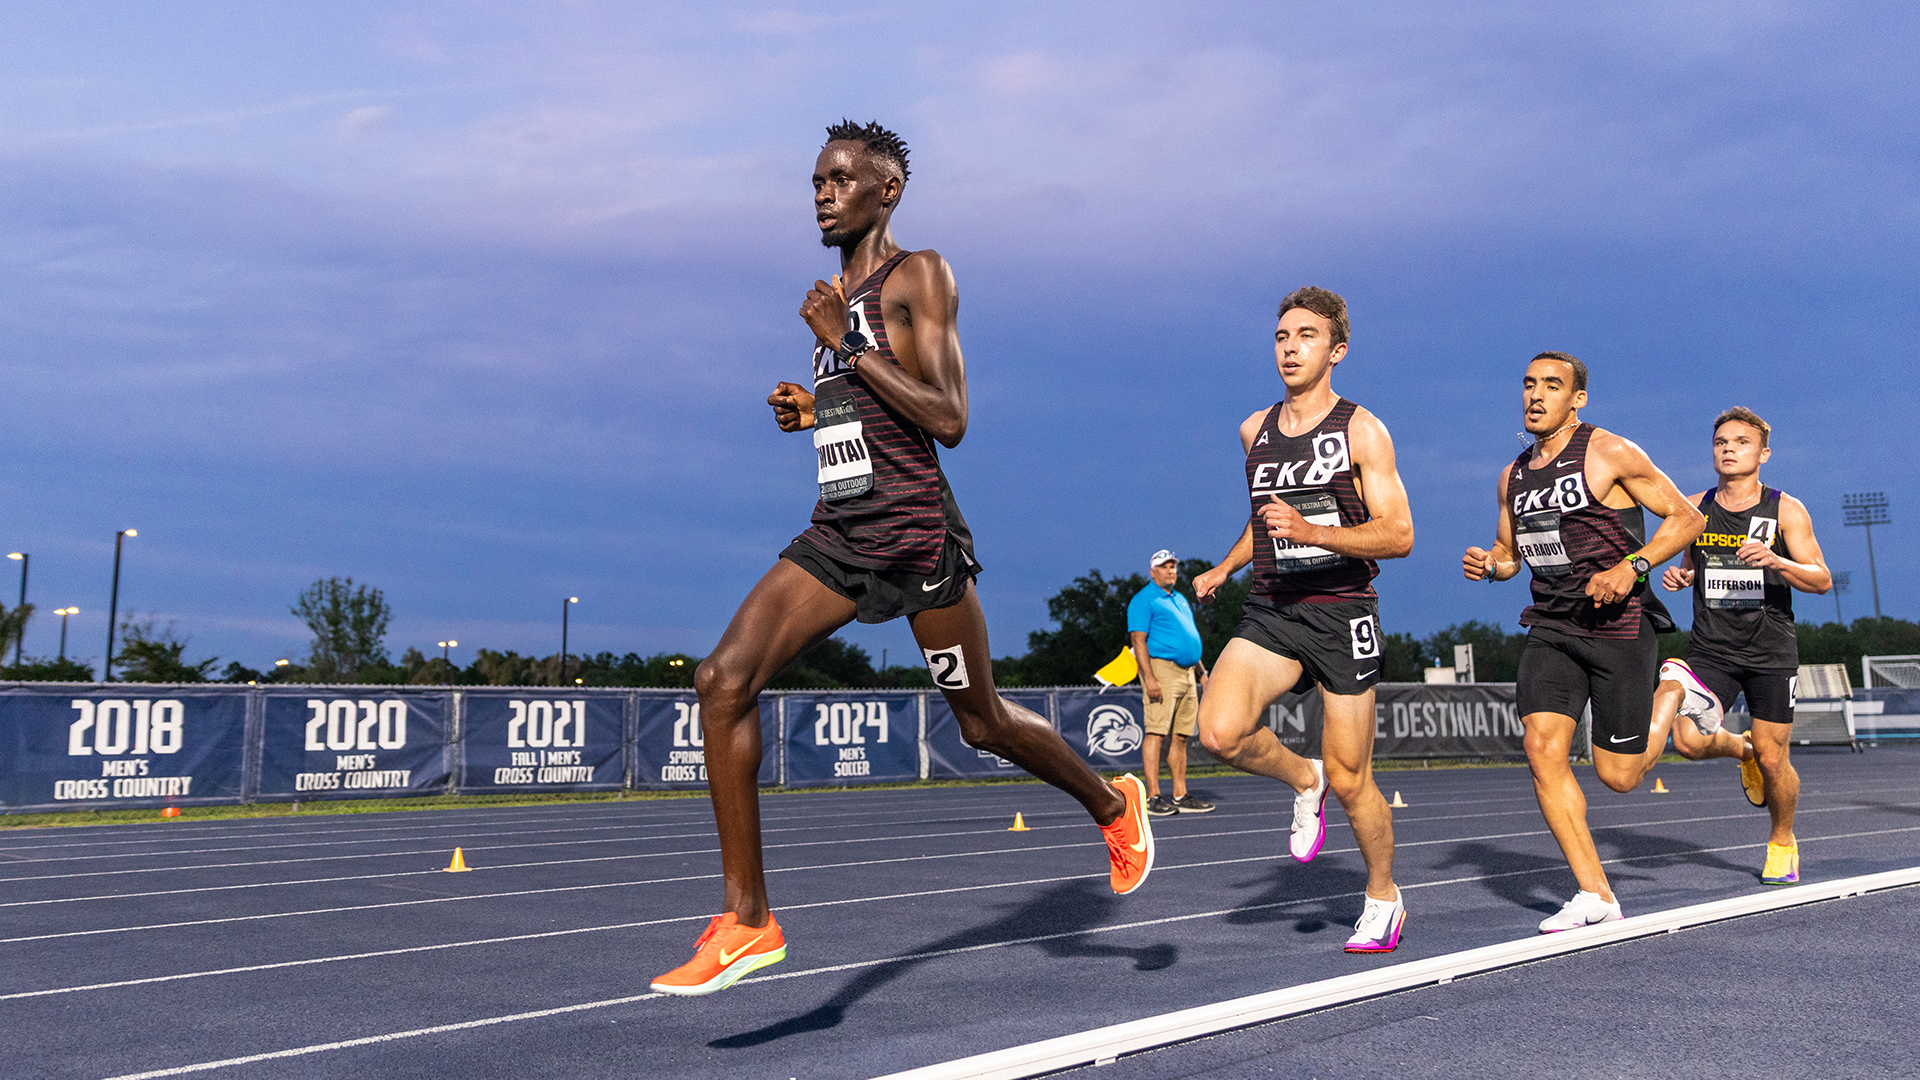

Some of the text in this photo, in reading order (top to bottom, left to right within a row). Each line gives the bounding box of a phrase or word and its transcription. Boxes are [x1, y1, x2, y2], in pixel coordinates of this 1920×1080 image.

[817, 438, 867, 470] MUTAI
[838, 477, 868, 491] OUTDOOR
[1560, 477, 1582, 508] 8
[1751, 520, 1770, 545] 4
[1312, 554, 1341, 565] OUTDOOR
[1520, 545, 1534, 558] ER
[1708, 579, 1762, 590] JEFFERSON
[1355, 620, 1375, 655] 9
[931, 652, 963, 686] 2
[68, 700, 184, 756] 2018
[305, 700, 408, 751] 2020
[507, 700, 587, 748] 2021
[673, 702, 704, 747] 20
[815, 702, 888, 745] 2024
[336, 754, 376, 770] MEN'S
[511, 751, 538, 766] FALL
[547, 750, 581, 765] MEN'S
[669, 751, 705, 764] SPRING
[838, 746, 866, 760] MEN'S
[102, 759, 149, 777] MEN'S
[494, 765, 596, 785] CROSS COUNTRY
[662, 765, 697, 781] CROSS
[834, 761, 871, 777] SOCCER
[54, 776, 193, 800] CROSS COUNTRY
[295, 769, 412, 791] CROSS COUNTRY
